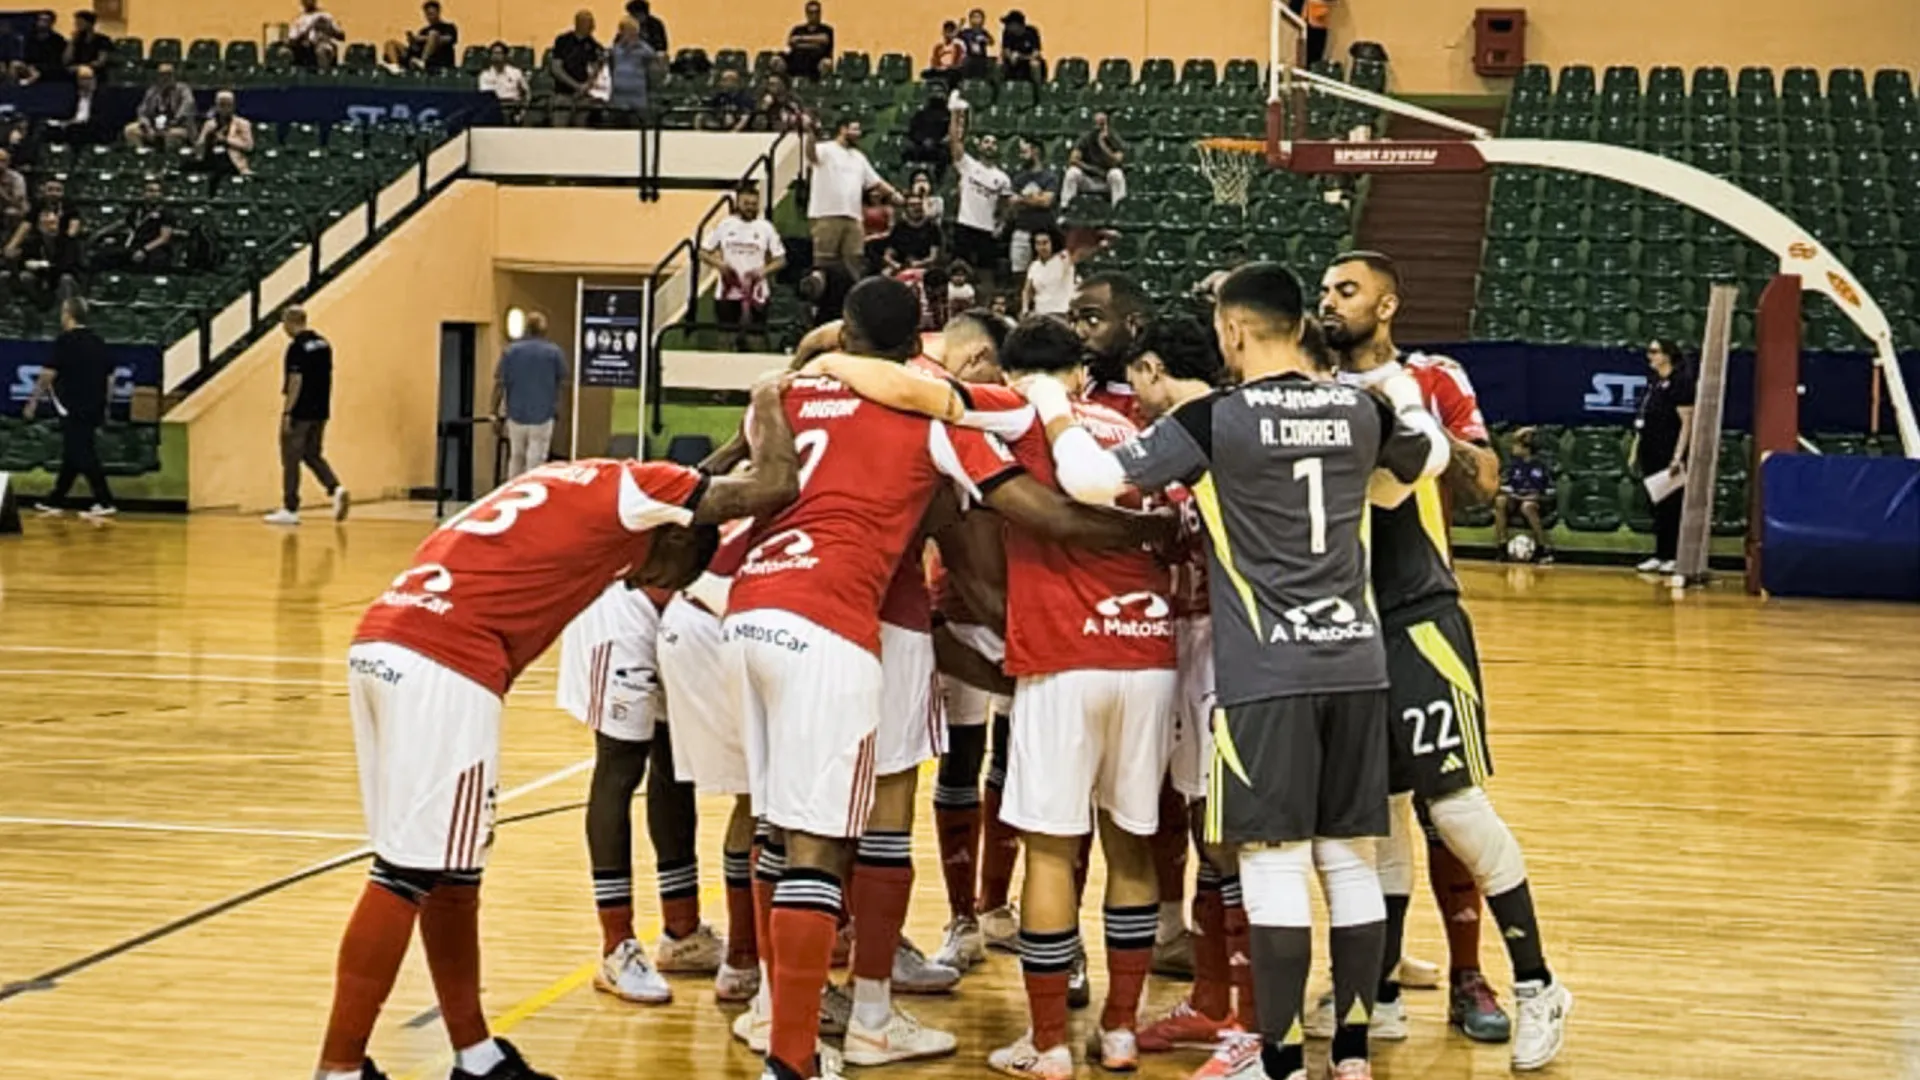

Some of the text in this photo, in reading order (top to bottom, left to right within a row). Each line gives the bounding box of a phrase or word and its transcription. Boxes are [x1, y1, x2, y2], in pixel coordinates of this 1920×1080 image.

[1280, 419, 1352, 446] CORREIA
[1293, 457, 1326, 554] 1
[1083, 618, 1170, 637] A MatosC
[1270, 623, 1290, 643] A
[1402, 699, 1461, 756] 22
